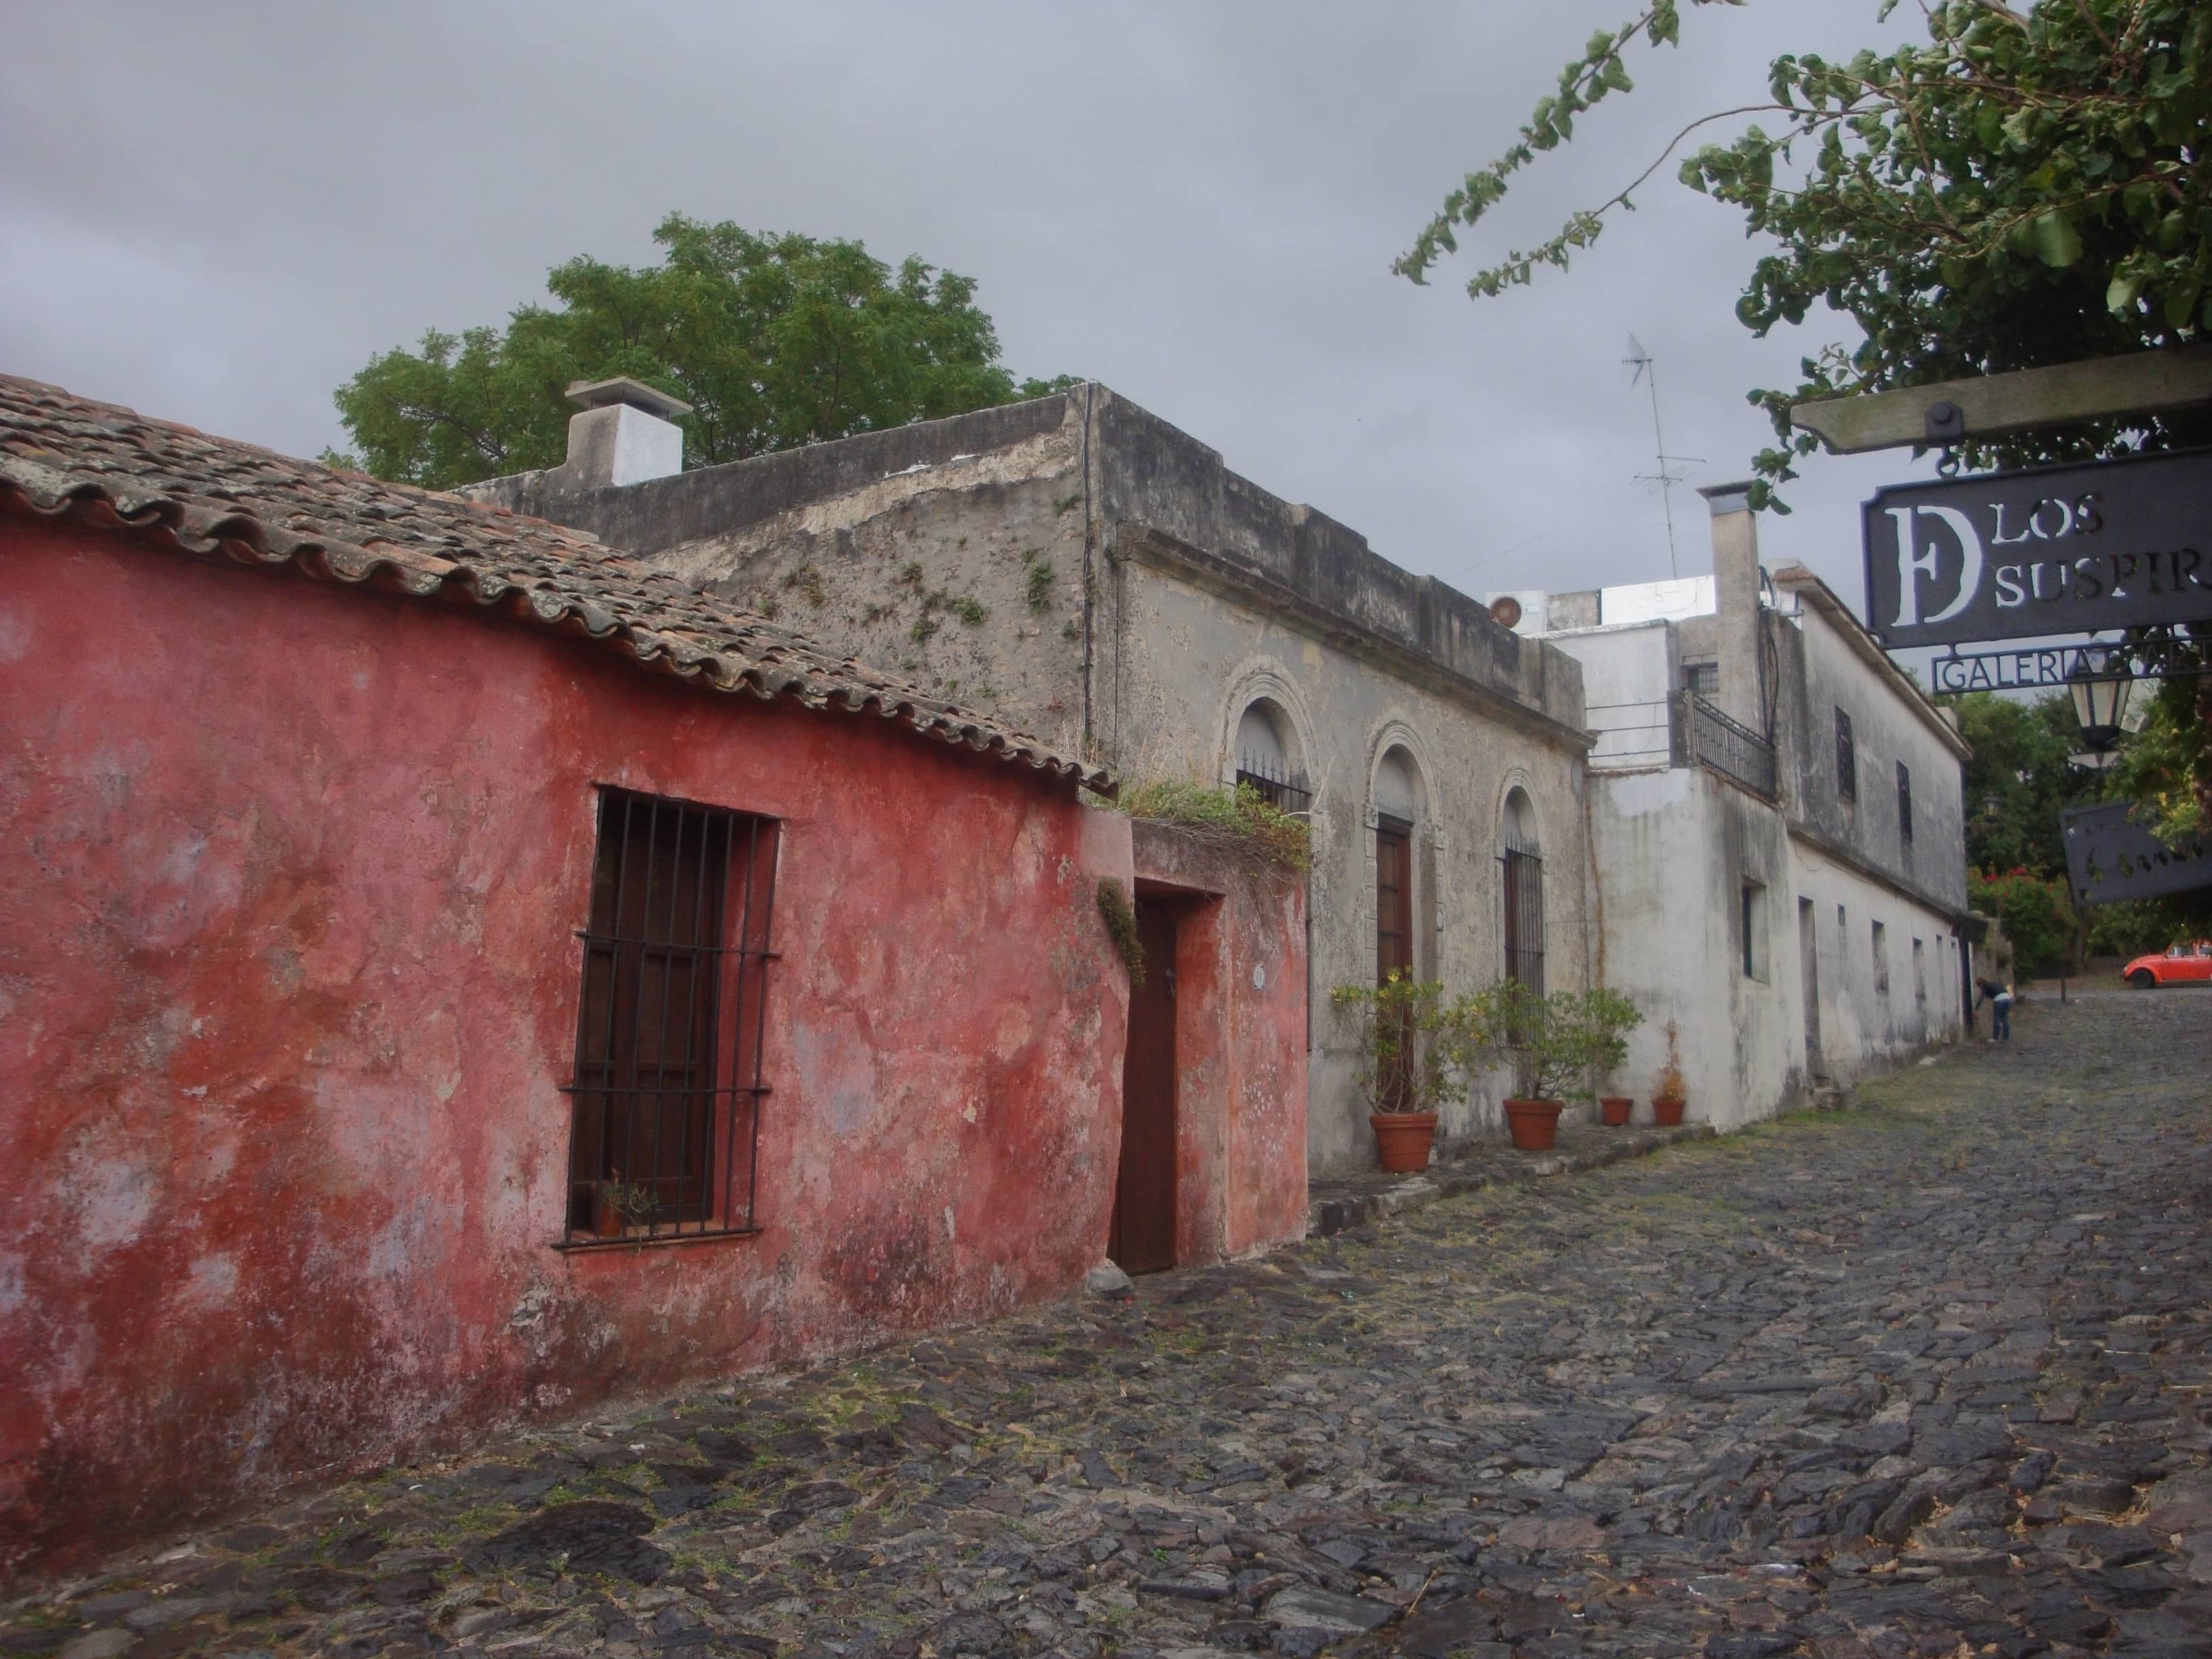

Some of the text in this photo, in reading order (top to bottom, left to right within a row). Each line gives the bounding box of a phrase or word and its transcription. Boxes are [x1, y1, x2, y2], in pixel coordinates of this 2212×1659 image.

[1988, 493, 2104, 544] LOS
[1994, 548, 2212, 608] SUSPIR
[1941, 647, 2094, 690] GALERIA
